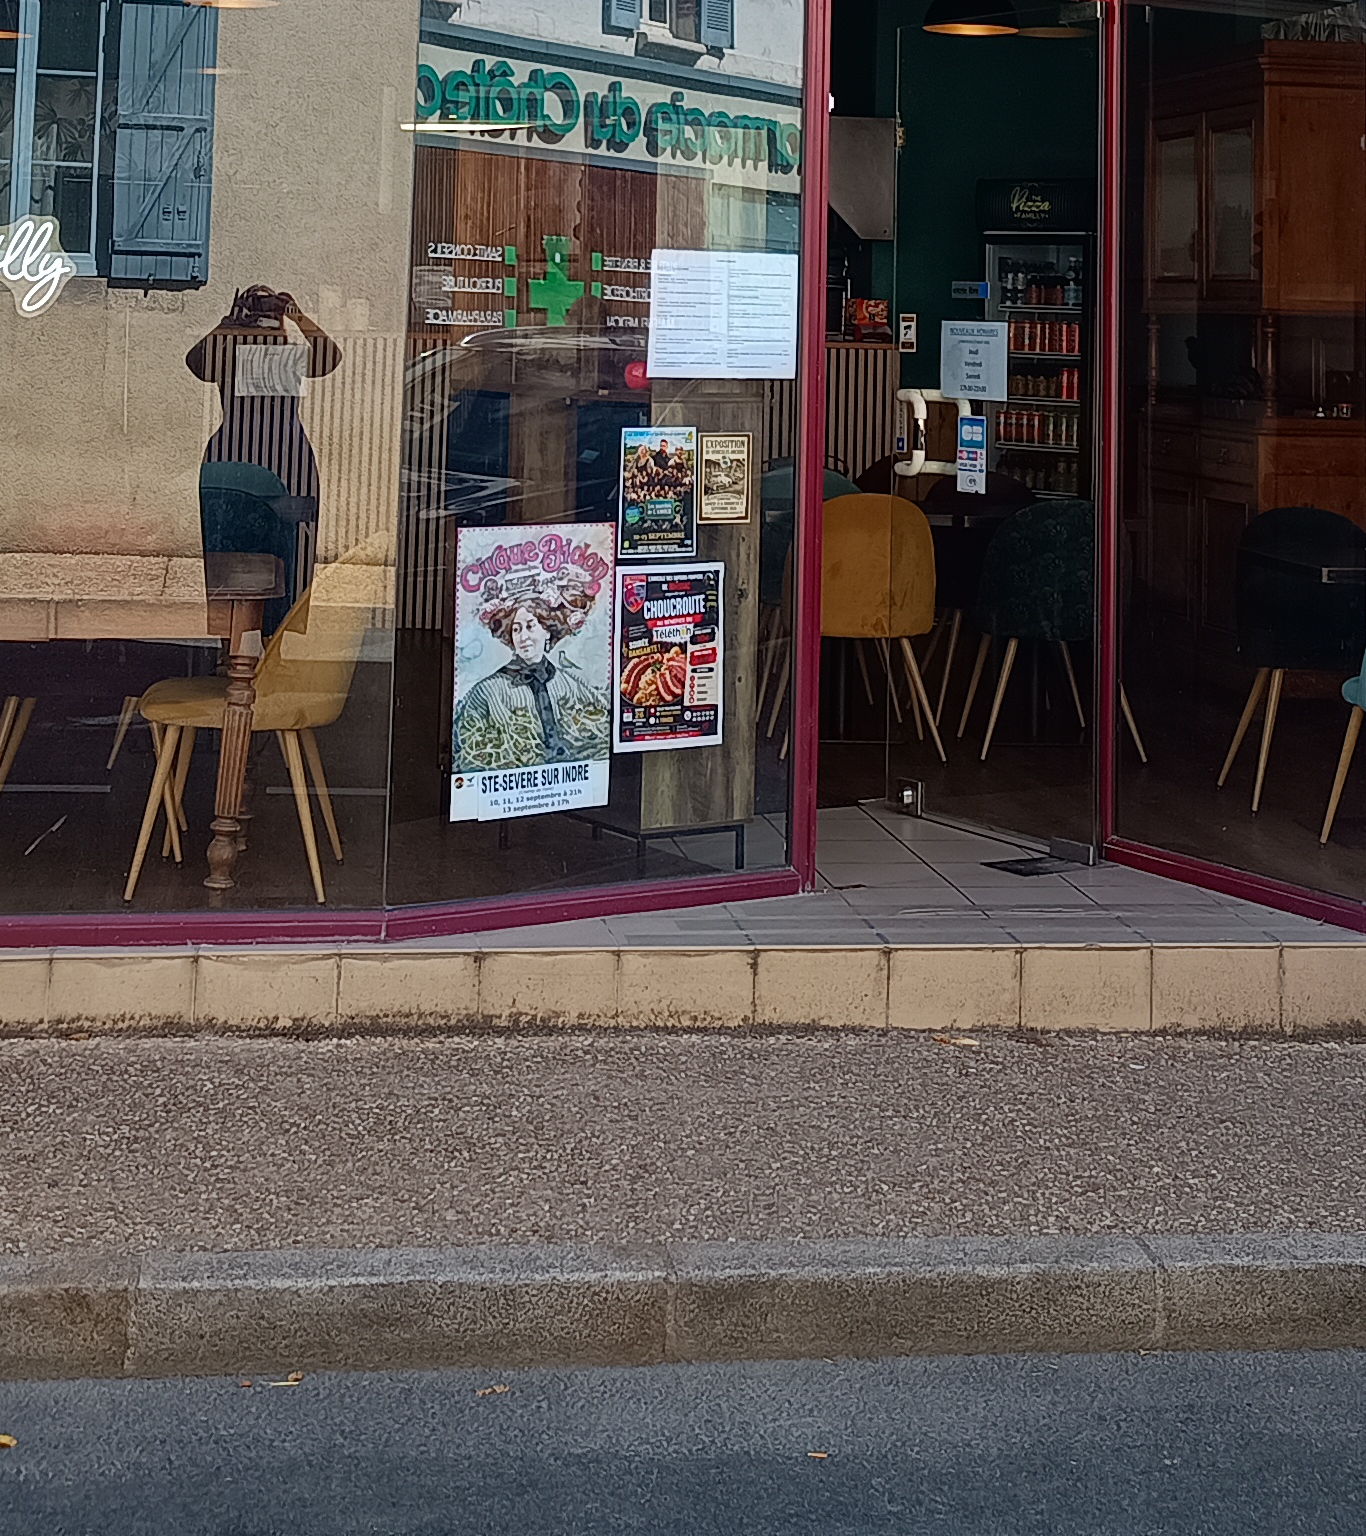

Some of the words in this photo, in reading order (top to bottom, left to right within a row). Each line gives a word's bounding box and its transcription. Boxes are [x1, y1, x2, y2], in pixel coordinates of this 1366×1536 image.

[1011, 186, 1051, 212] Pizza
[705, 440, 745, 449] EXPOSITION
[460, 541, 539, 593] Cirque
[644, 594, 705, 619] CHOUCROUTE
[481, 770, 538, 794] STE-SEVERE
[541, 767, 559, 786] SUR
[562, 764, 589, 782] INDRE
[513, 802, 550, 812] septembre
[526, 791, 562, 802] septembre
